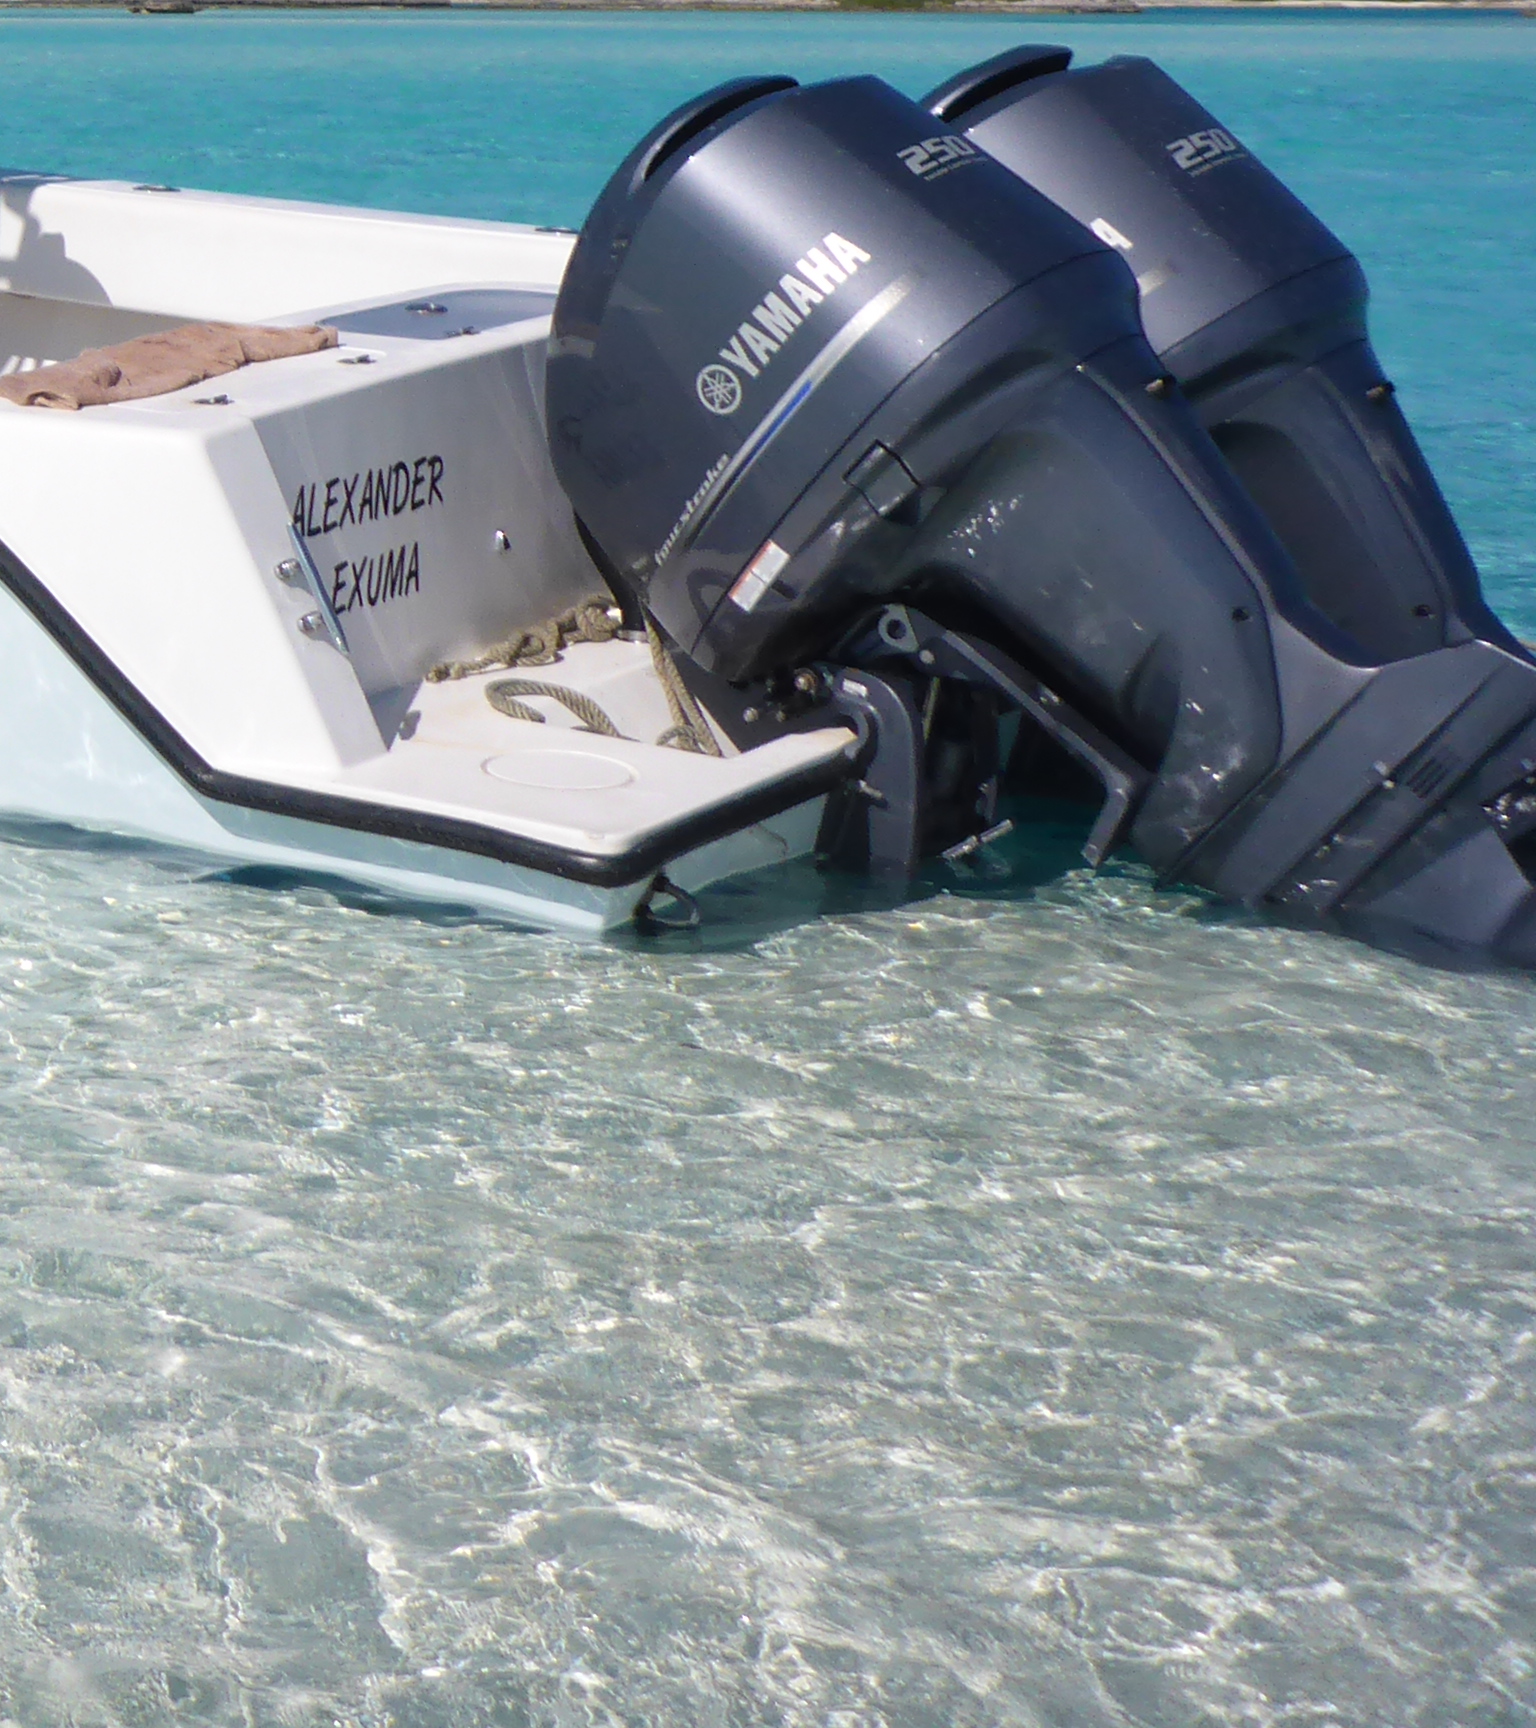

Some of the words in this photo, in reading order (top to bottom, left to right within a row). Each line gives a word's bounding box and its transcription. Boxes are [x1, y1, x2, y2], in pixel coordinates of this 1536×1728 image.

[896, 135, 975, 176] 250
[1166, 128, 1236, 170] 250
[718, 231, 872, 378] YAMAHA
[292, 455, 444, 537] ALEXANDER
[330, 542, 420, 615] EXUMA
